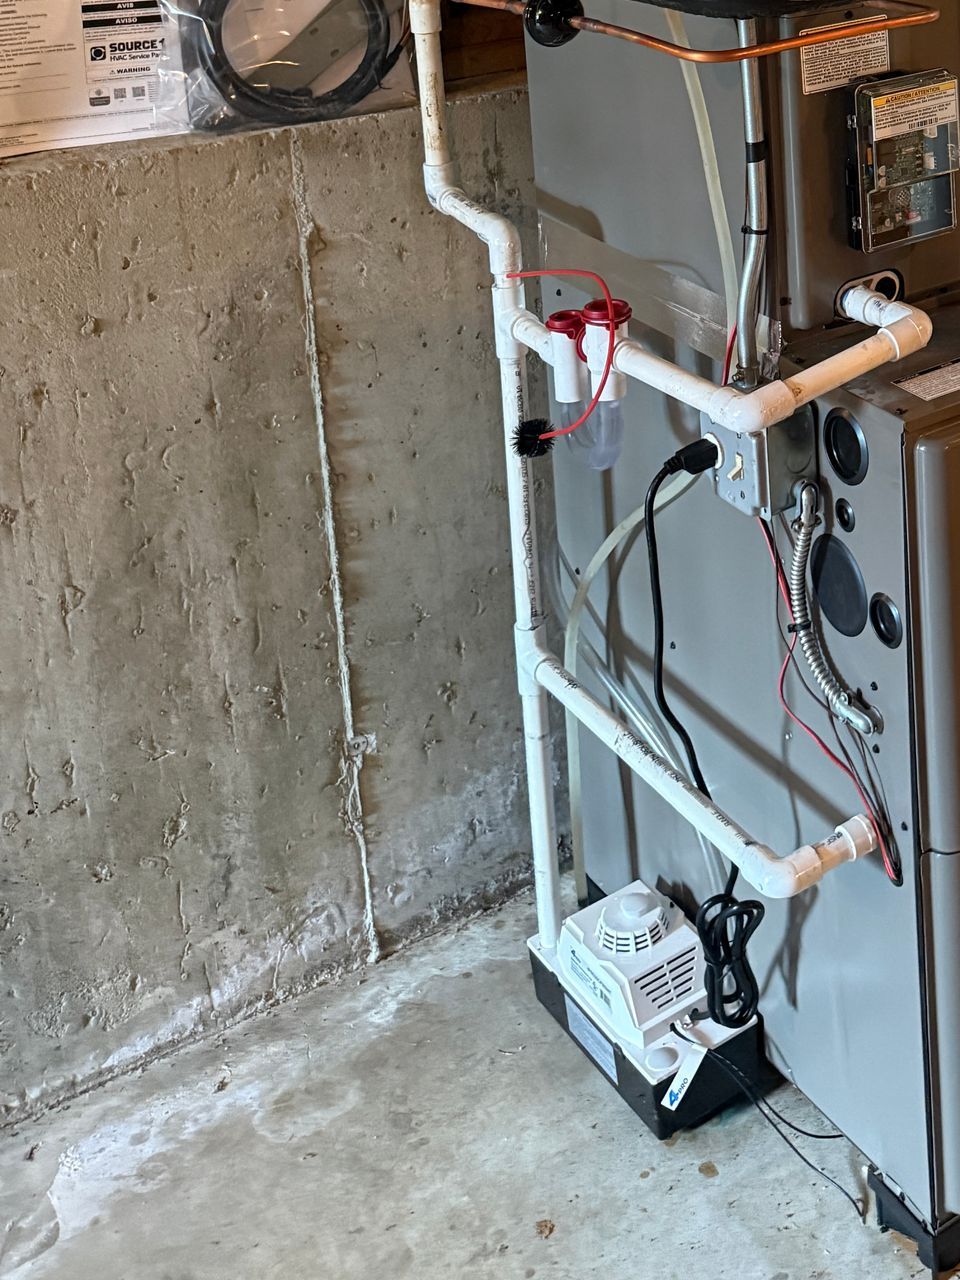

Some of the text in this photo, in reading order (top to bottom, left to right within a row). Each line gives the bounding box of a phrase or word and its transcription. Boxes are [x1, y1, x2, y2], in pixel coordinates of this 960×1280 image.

[109, 39, 158, 53] SOURCE
[110, 54, 128, 62] HVAC
[129, 52, 150, 61] Service
[116, 66, 151, 74] WARNING
[890, 92, 912, 102] CAUTION
[914, 86, 940, 96] ATTENTION
[678, 1077, 689, 1094] PRO
